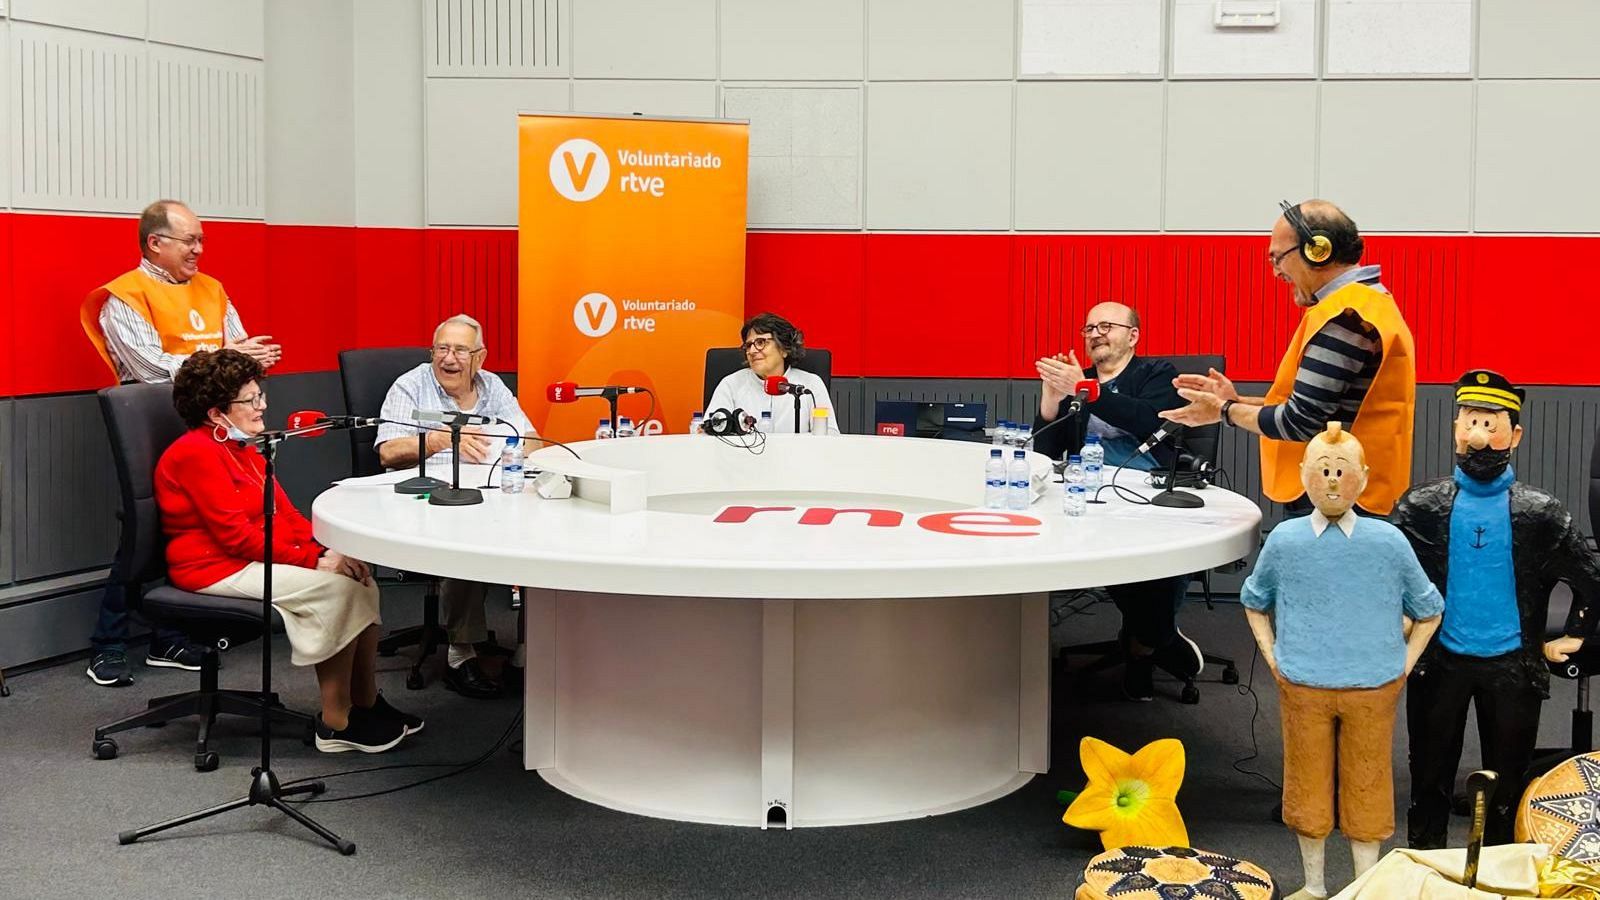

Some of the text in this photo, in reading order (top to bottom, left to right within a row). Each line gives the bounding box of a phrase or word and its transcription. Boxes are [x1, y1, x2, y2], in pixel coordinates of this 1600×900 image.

[618, 150, 721, 168] Voluntariado
[562, 151, 597, 192] V
[621, 173, 664, 196] rtve
[622, 299, 695, 311] Voluntariado
[583, 301, 607, 330] V
[624, 315, 655, 332] rtve
[882, 424, 899, 435] rne
[713, 506, 1042, 536] rne
